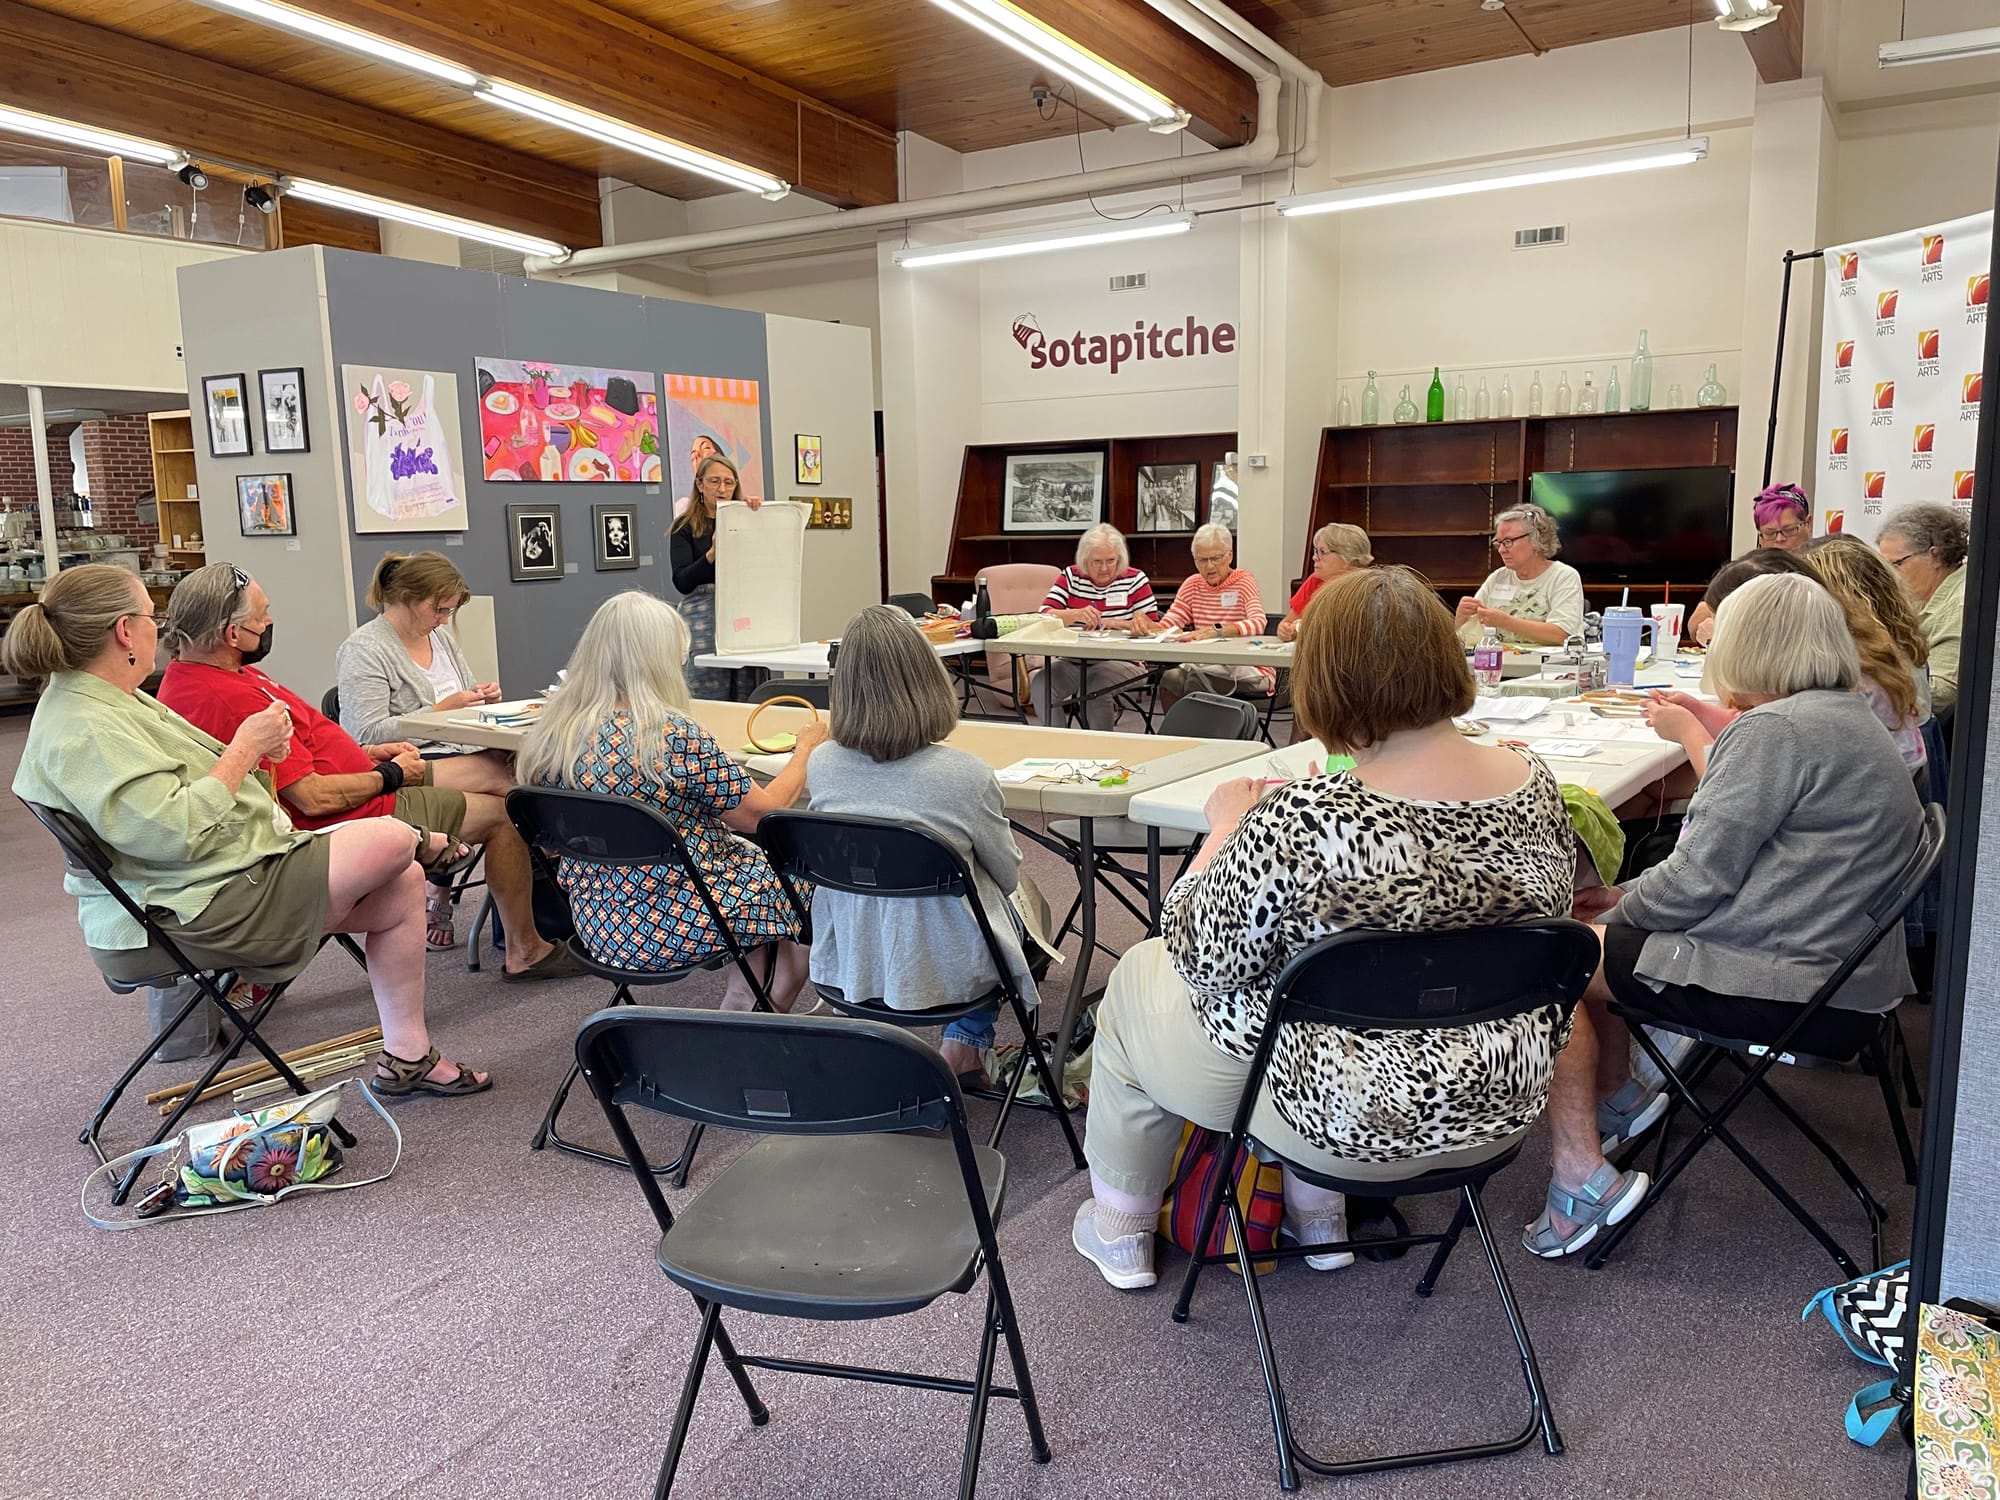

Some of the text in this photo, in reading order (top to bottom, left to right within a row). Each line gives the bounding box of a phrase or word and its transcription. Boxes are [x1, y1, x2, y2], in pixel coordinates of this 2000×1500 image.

[1922, 271, 1943, 283] ARTS
[1840, 286, 1856, 297] ARTS
[1967, 312, 1986, 324] ART
[1876, 325, 1895, 336] ARTS
[1918, 366, 1940, 377] ARTS
[1834, 374, 1851, 385] ARTS
[1871, 416, 1892, 427] ARTS
[1829, 461, 1848, 471] ARTS
[1911, 459, 1932, 470] ARTS
[1864, 505, 1881, 514] ARTS
